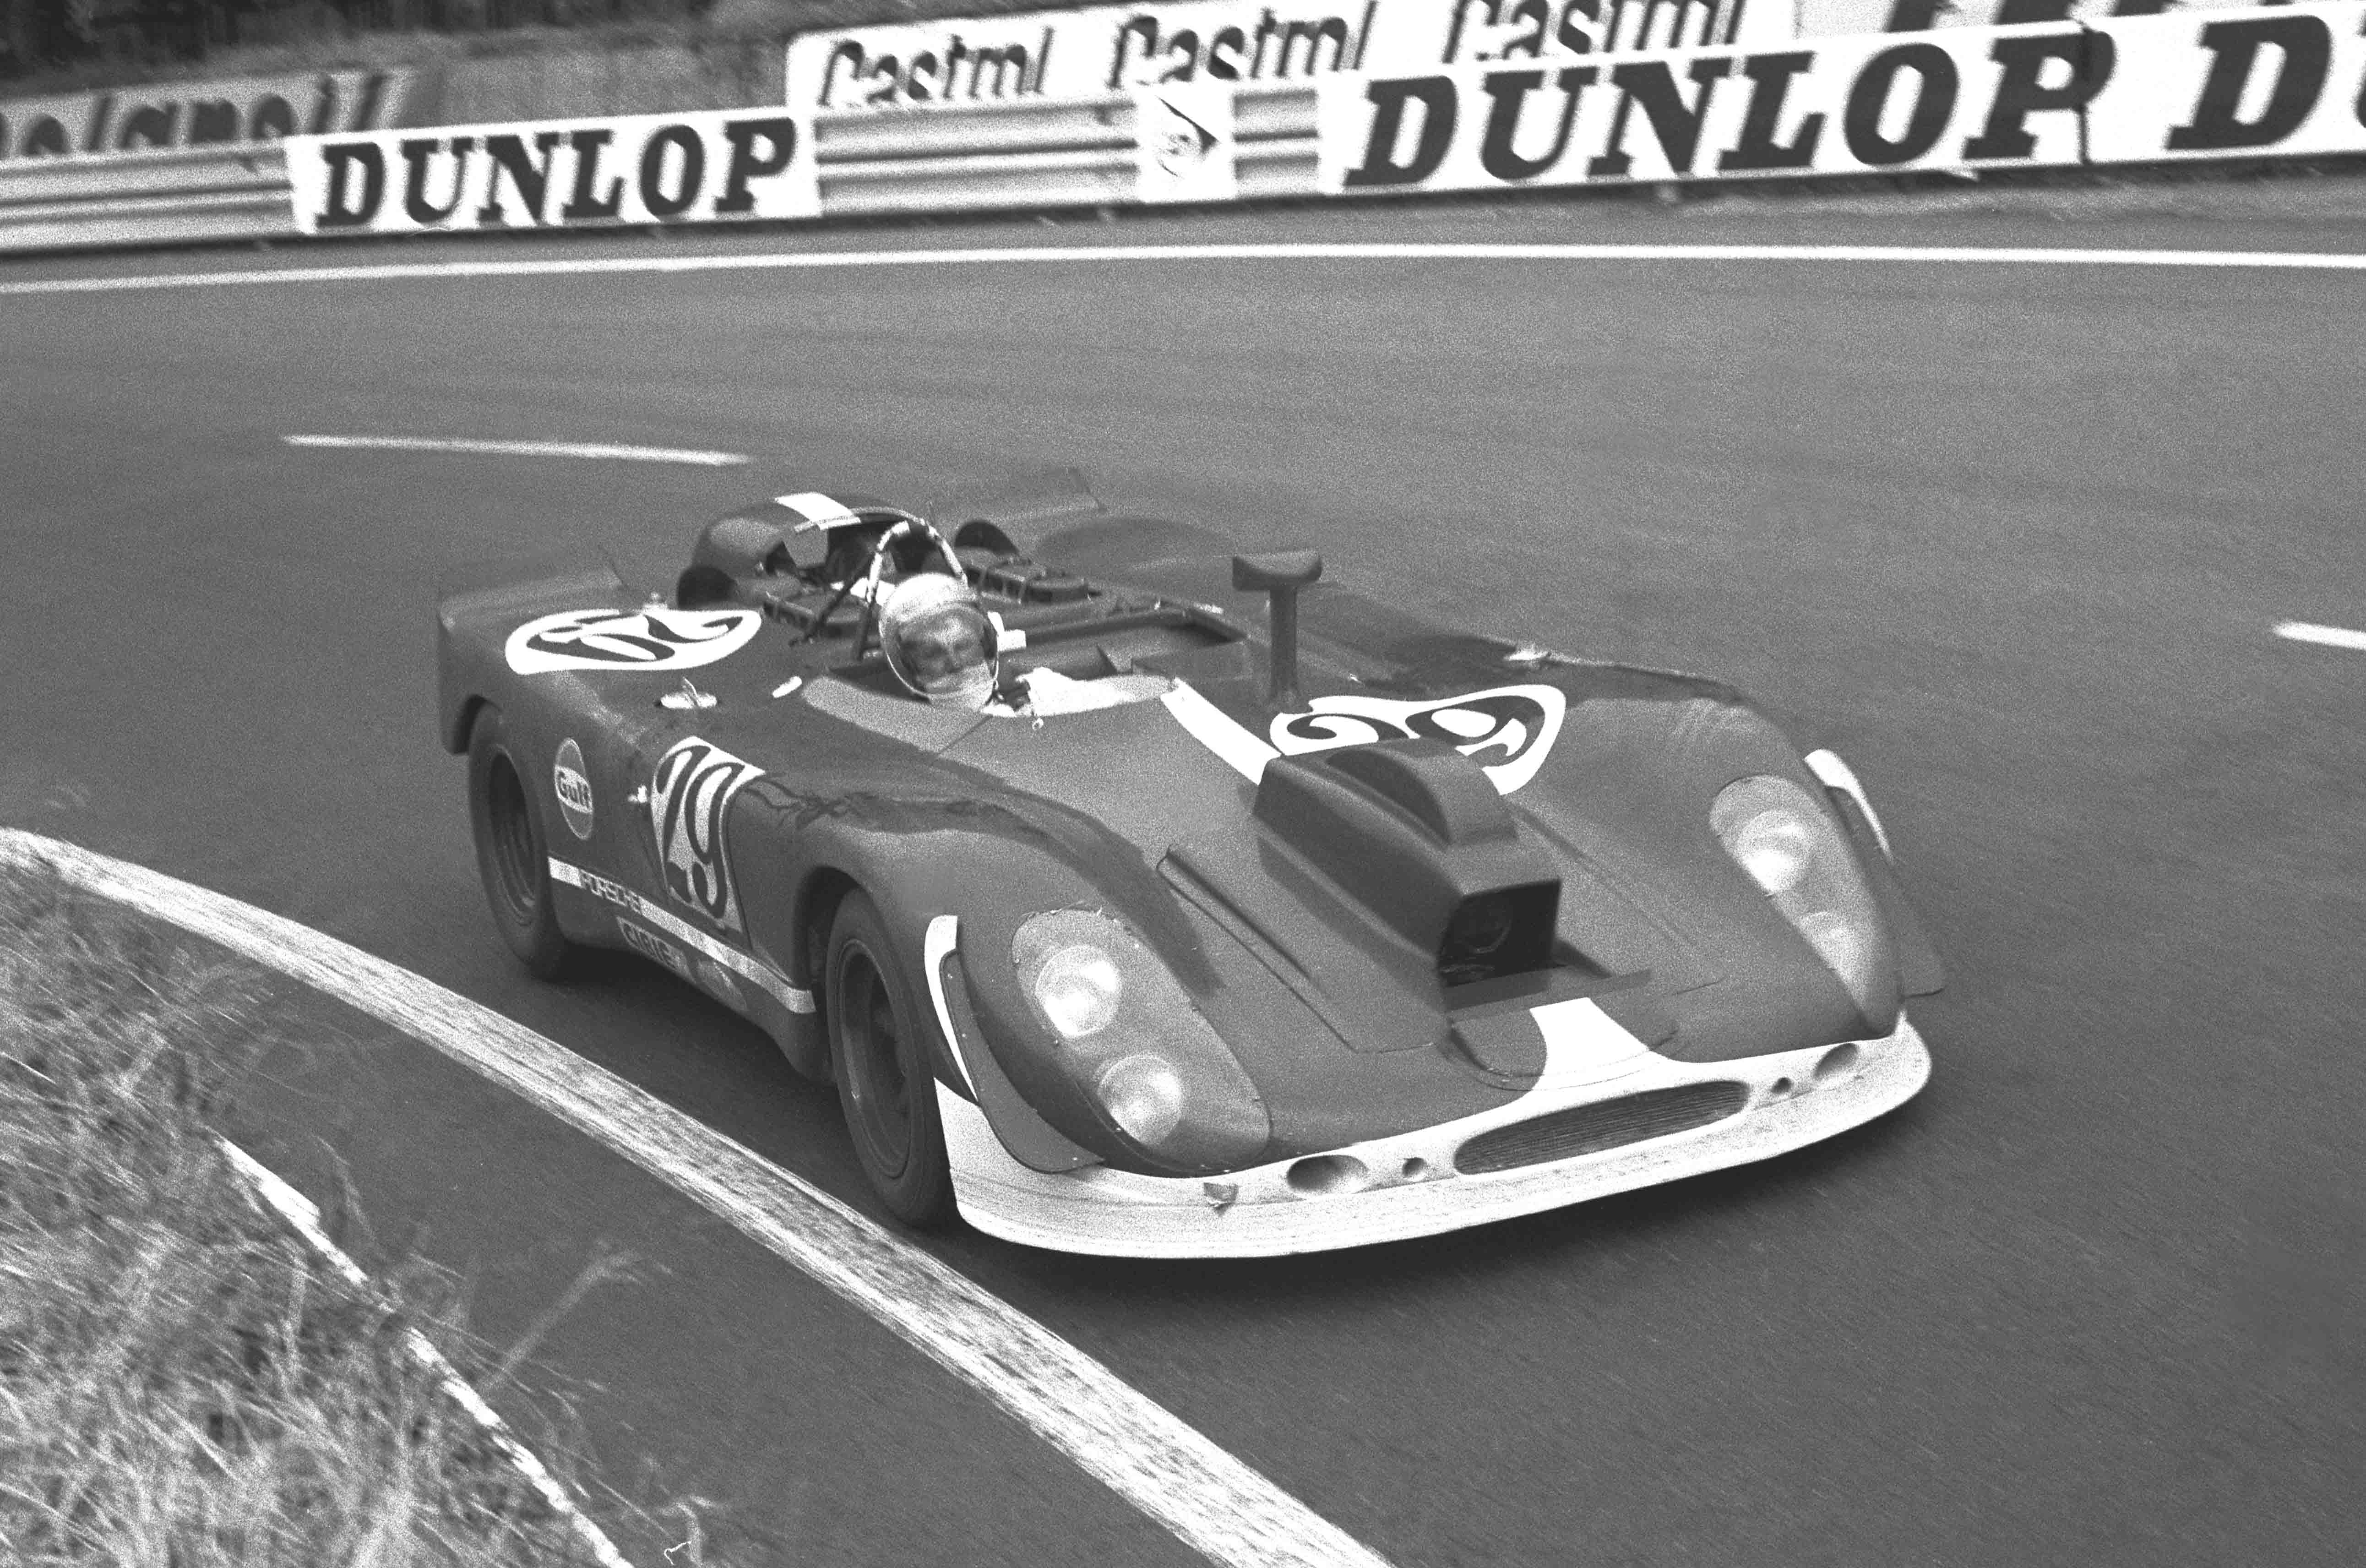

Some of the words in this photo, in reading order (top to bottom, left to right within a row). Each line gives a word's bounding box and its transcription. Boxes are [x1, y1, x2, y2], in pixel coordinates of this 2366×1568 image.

[1342, 30, 2116, 186] DUNLOP
[2164, 15, 2366, 151] D
[315, 116, 796, 228] DUNLOP
[556, 771, 591, 811] Gulf
